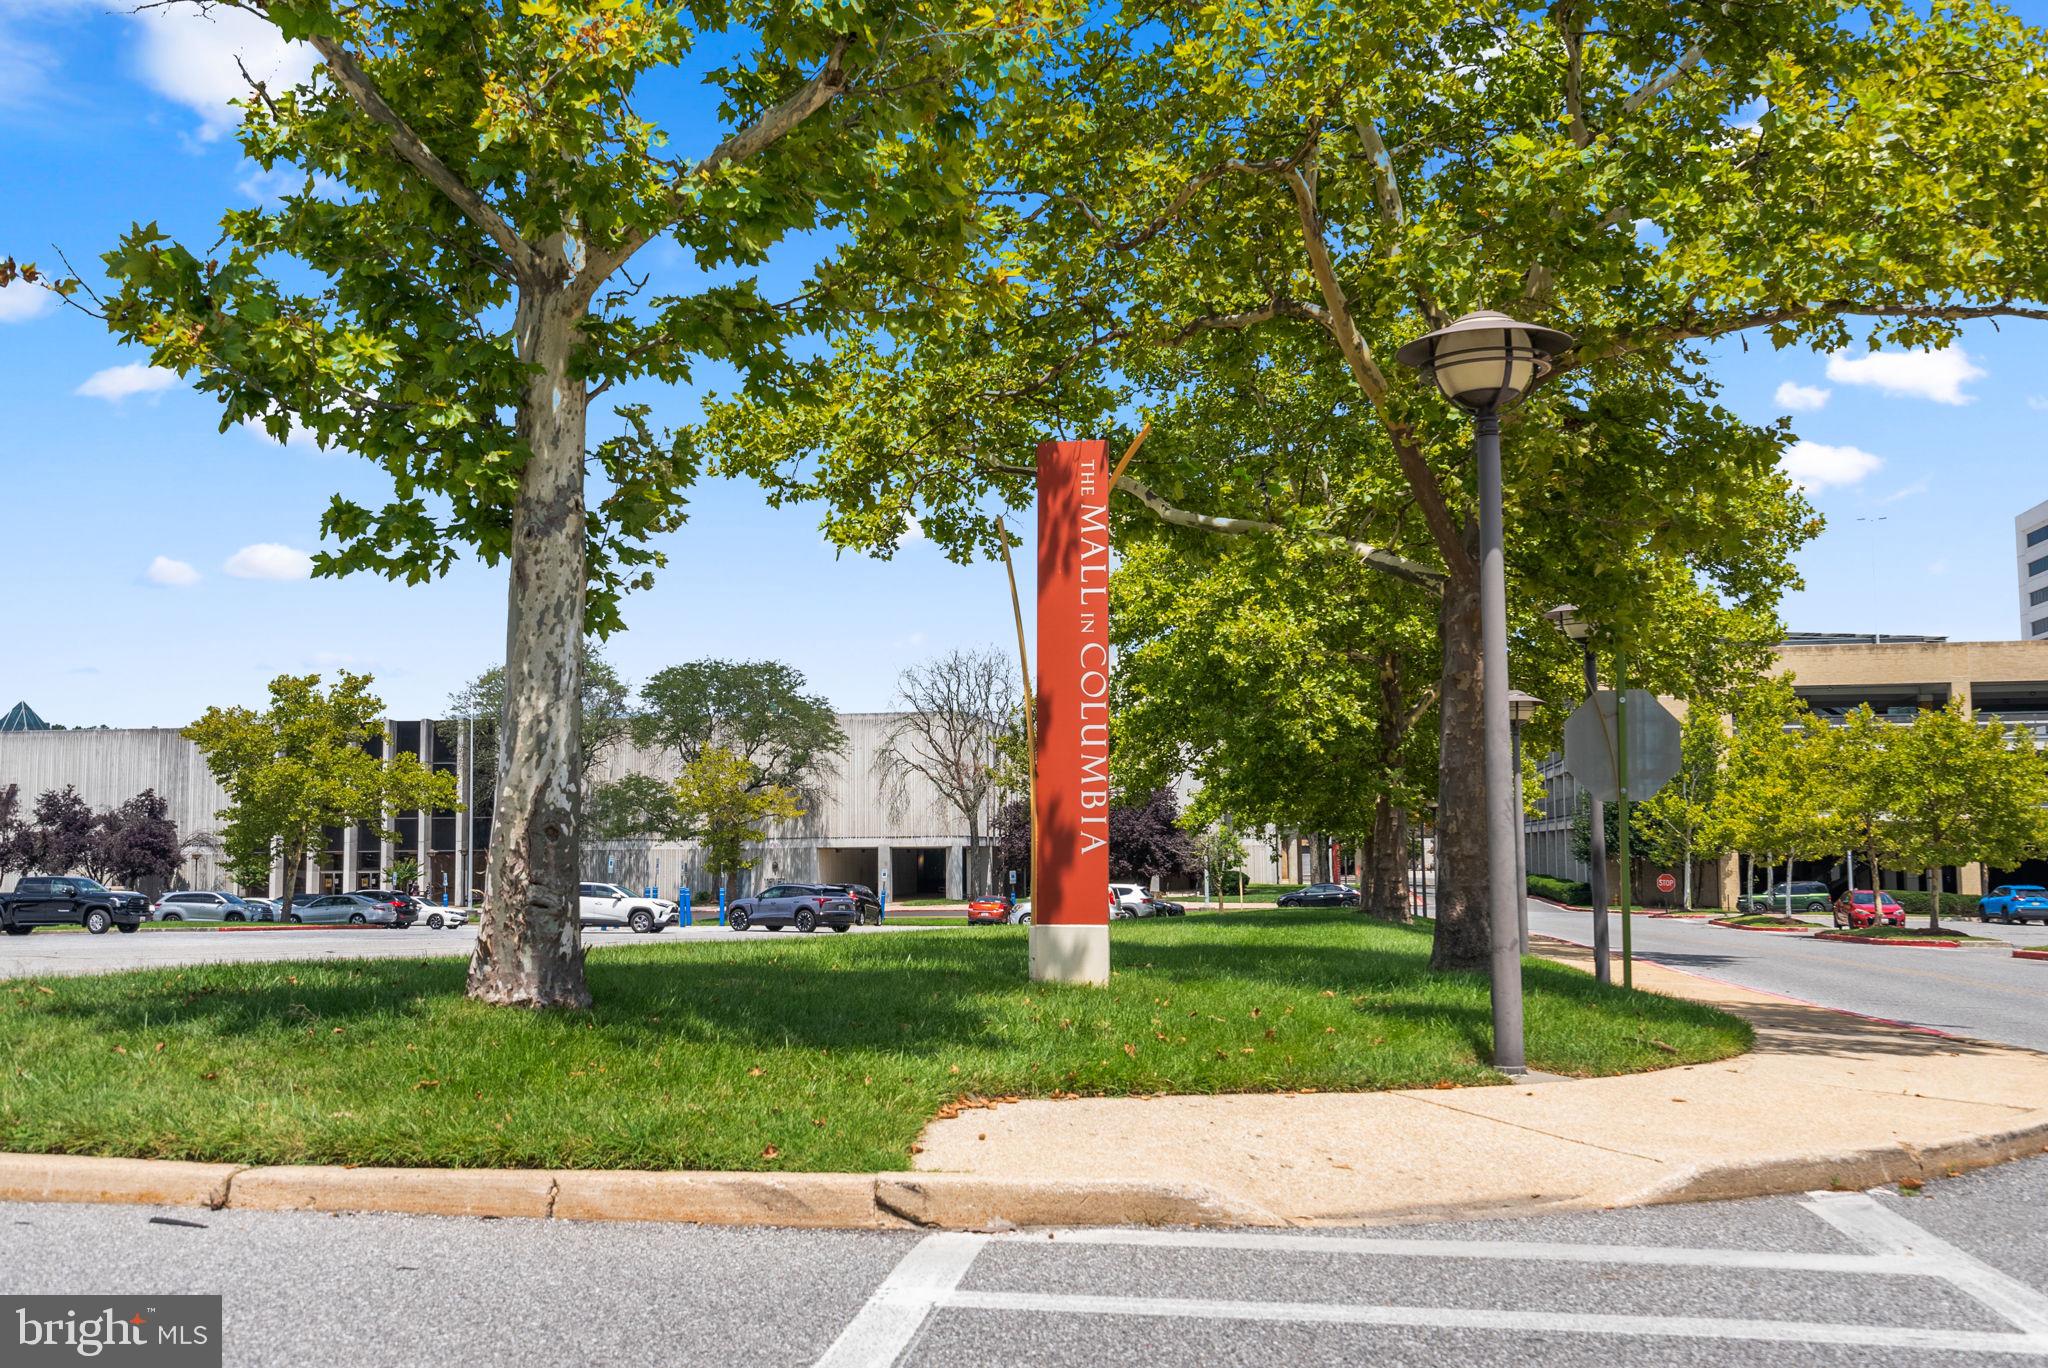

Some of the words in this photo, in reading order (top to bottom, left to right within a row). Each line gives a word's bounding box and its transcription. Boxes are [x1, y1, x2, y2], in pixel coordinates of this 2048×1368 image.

[1080, 459, 1095, 495] THE
[1080, 504, 1107, 605] MALL
[1080, 613, 1095, 633] IN
[1080, 642, 1107, 855] COLUMBIA
